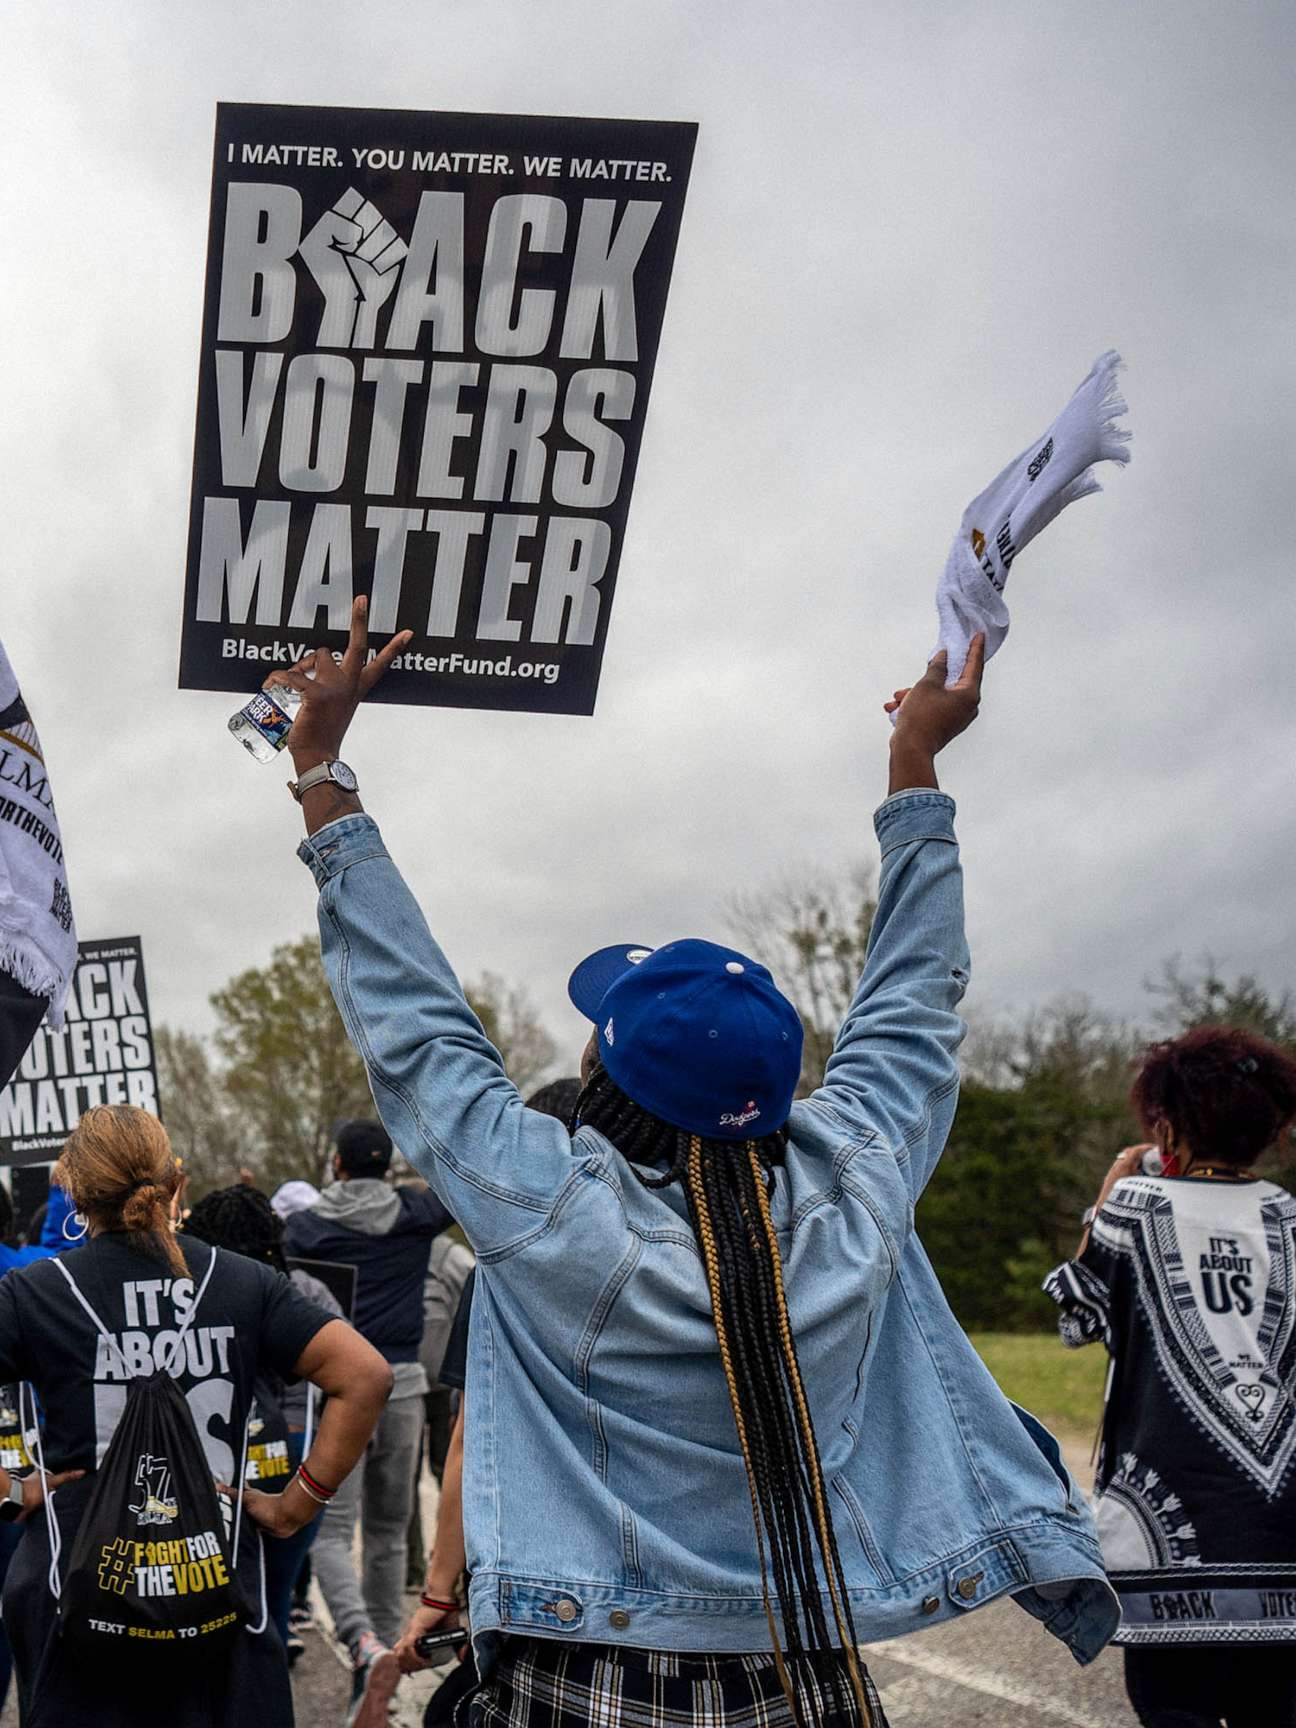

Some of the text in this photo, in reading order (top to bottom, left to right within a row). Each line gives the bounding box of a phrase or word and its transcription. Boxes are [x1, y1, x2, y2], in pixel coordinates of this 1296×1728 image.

[227, 143, 673, 184] I MATTER. YOU MATTER. WE MATTER.
[215, 350, 637, 508] VOTERS
[195, 496, 613, 646] MATTER
[12, 1016, 152, 1081] OTERS
[1199, 1253, 1253, 1273] ABOUT
[1209, 1237, 1240, 1254] IT'S
[122, 1278, 197, 1327] IT'S
[1201, 1272, 1253, 1317] US
[93, 1326, 235, 1380] ABOUT
[1258, 1591, 1296, 1618] VOTE
[88, 1618, 126, 1635] TEXT
[128, 1626, 176, 1640] SELMA
[178, 1627, 198, 1639] TO
